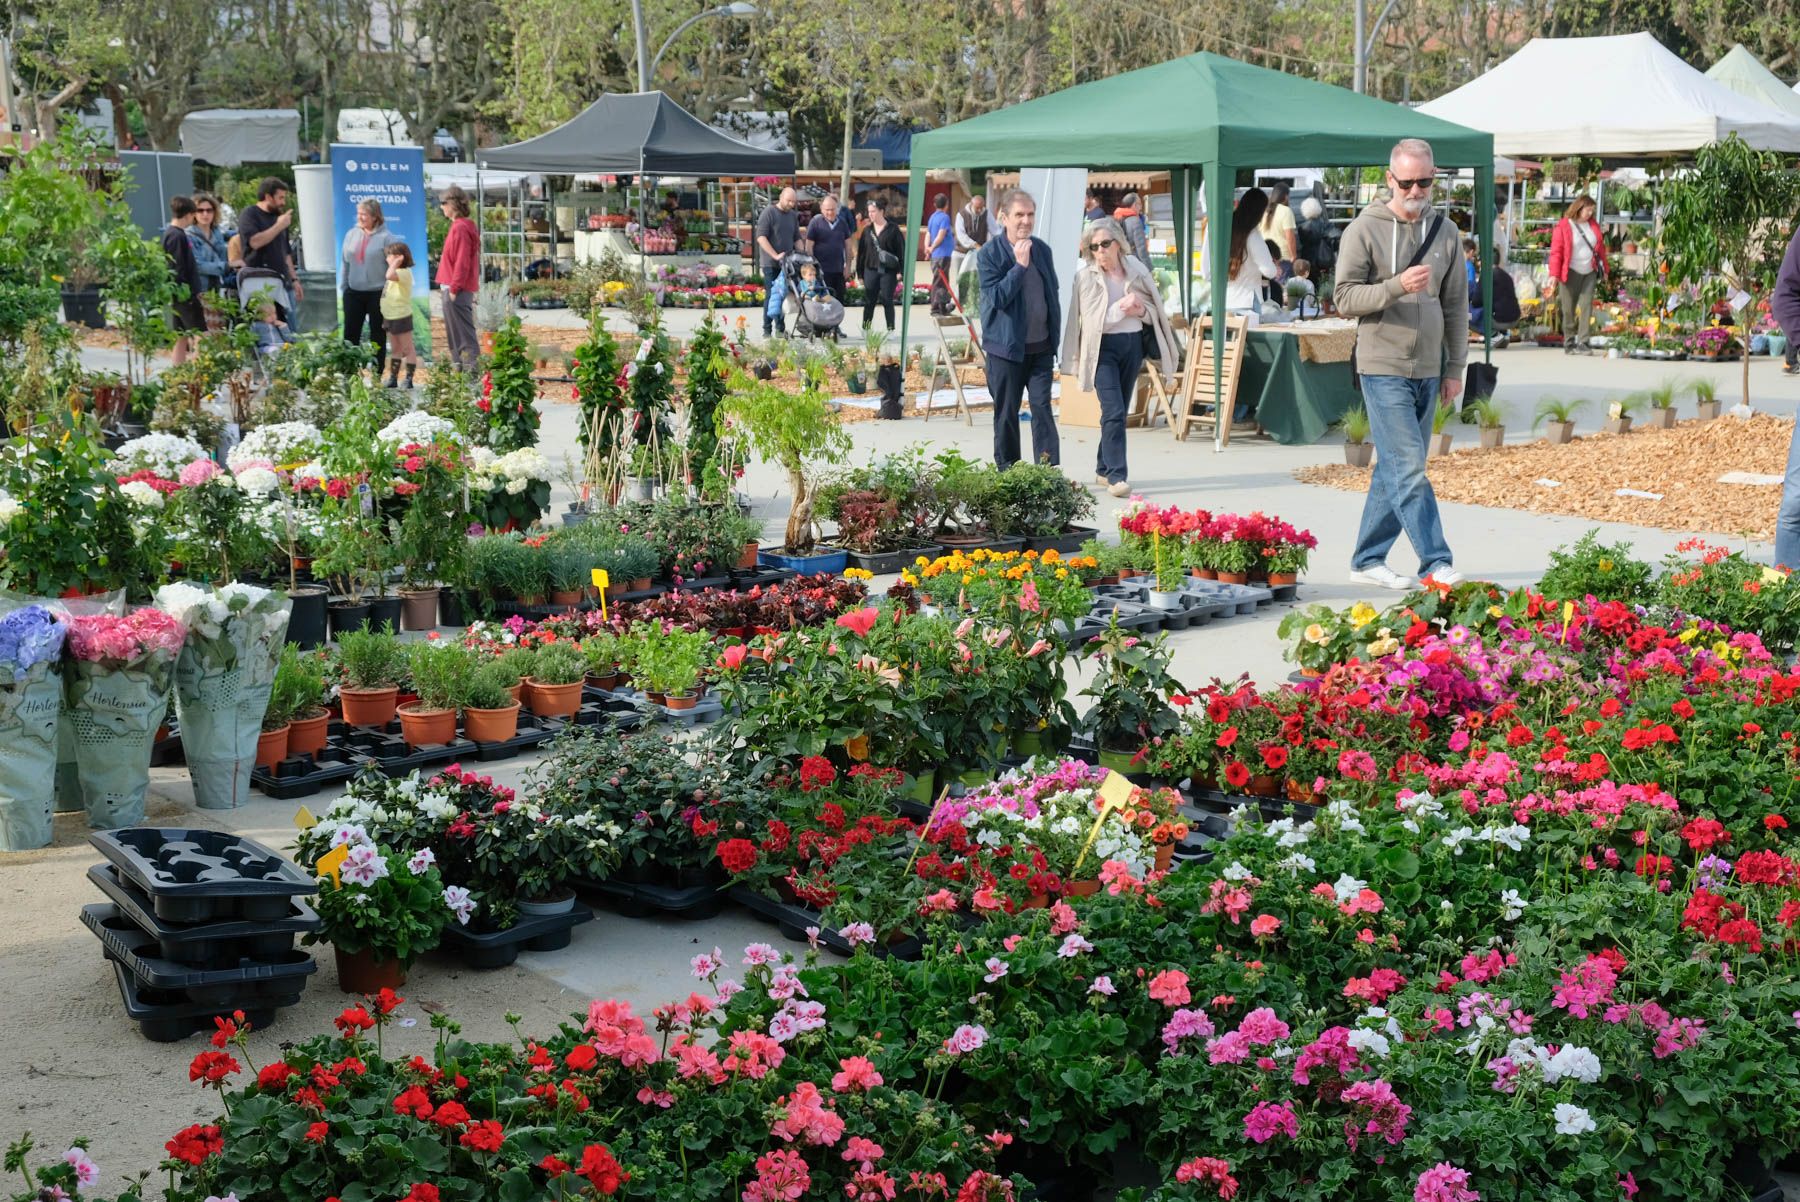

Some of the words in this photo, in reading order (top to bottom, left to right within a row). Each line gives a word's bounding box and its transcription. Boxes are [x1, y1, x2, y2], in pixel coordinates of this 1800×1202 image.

[361, 162, 409, 172] SOLEM
[345, 184, 412, 193] AGRICULTURA
[89, 691, 146, 709] Hortensia
